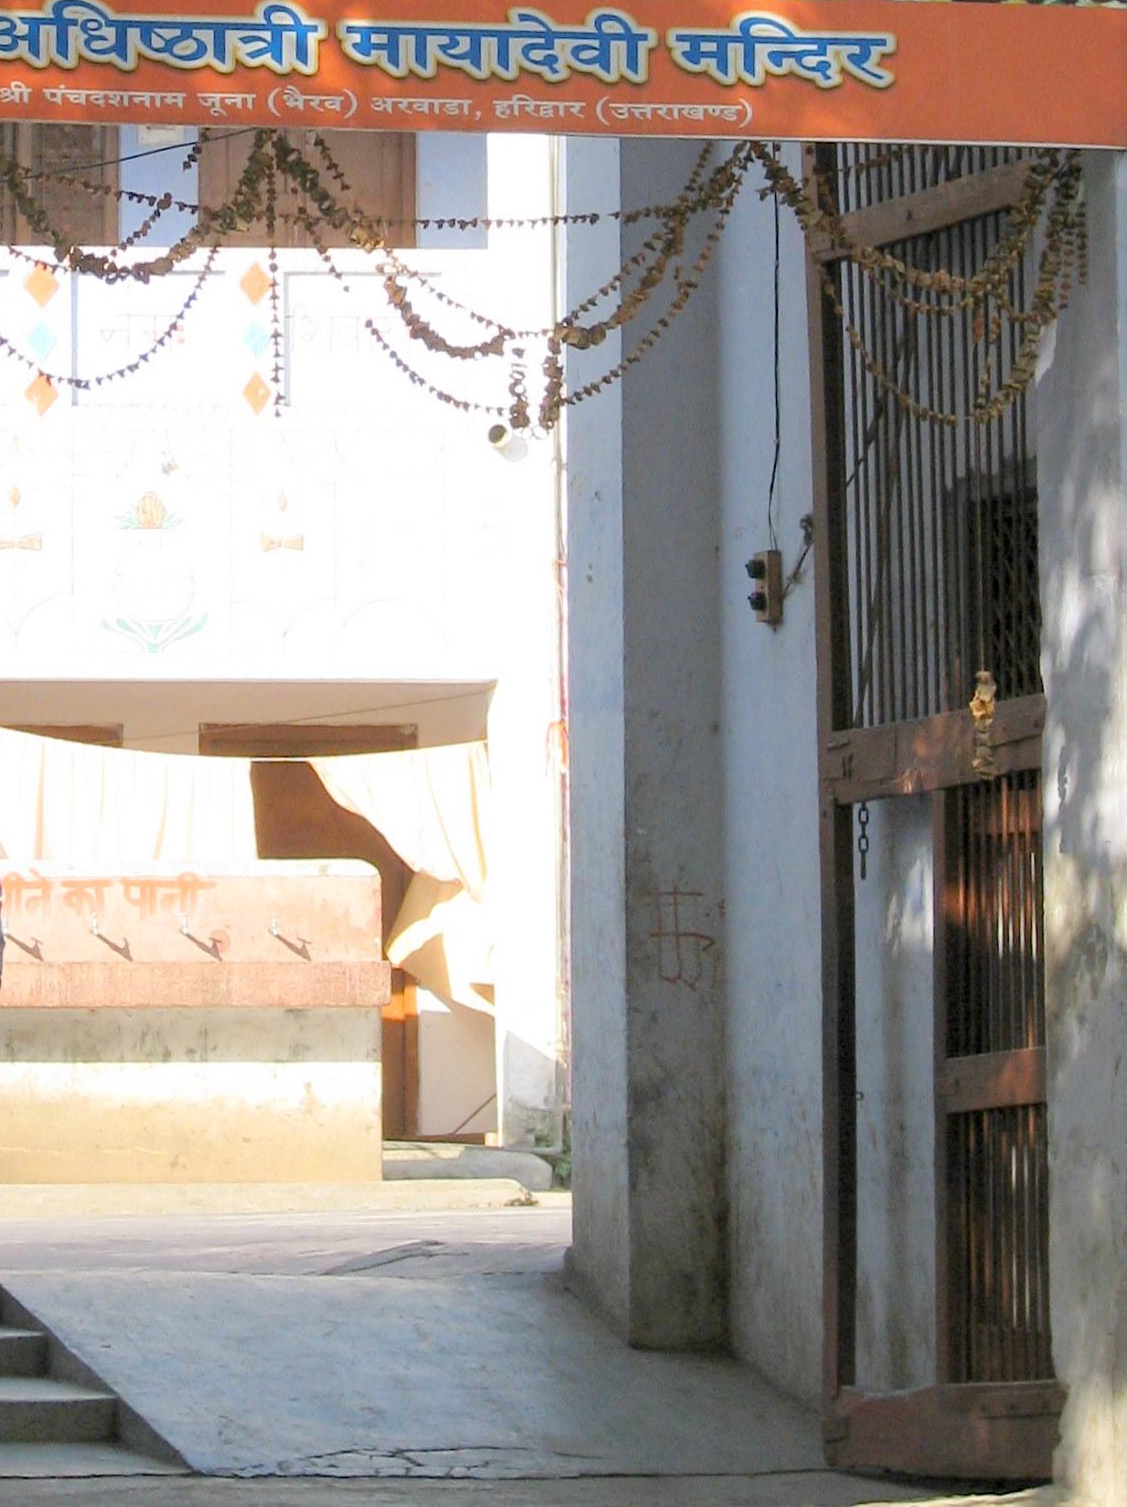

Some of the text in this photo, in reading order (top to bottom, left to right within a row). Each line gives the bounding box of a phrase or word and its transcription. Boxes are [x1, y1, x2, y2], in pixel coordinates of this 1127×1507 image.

[342, 10, 652, 79] मायादेवी
[673, 14, 889, 82] मन्दिर
[42, 84, 186, 110] पंचदशनाम
[197, 92, 257, 116] जूना
[267, 85, 358, 119] (भैरव)
[492, 93, 586, 119] हरिद्वार
[60, 878, 113, 918] का
[119, 871, 217, 921] पानी
